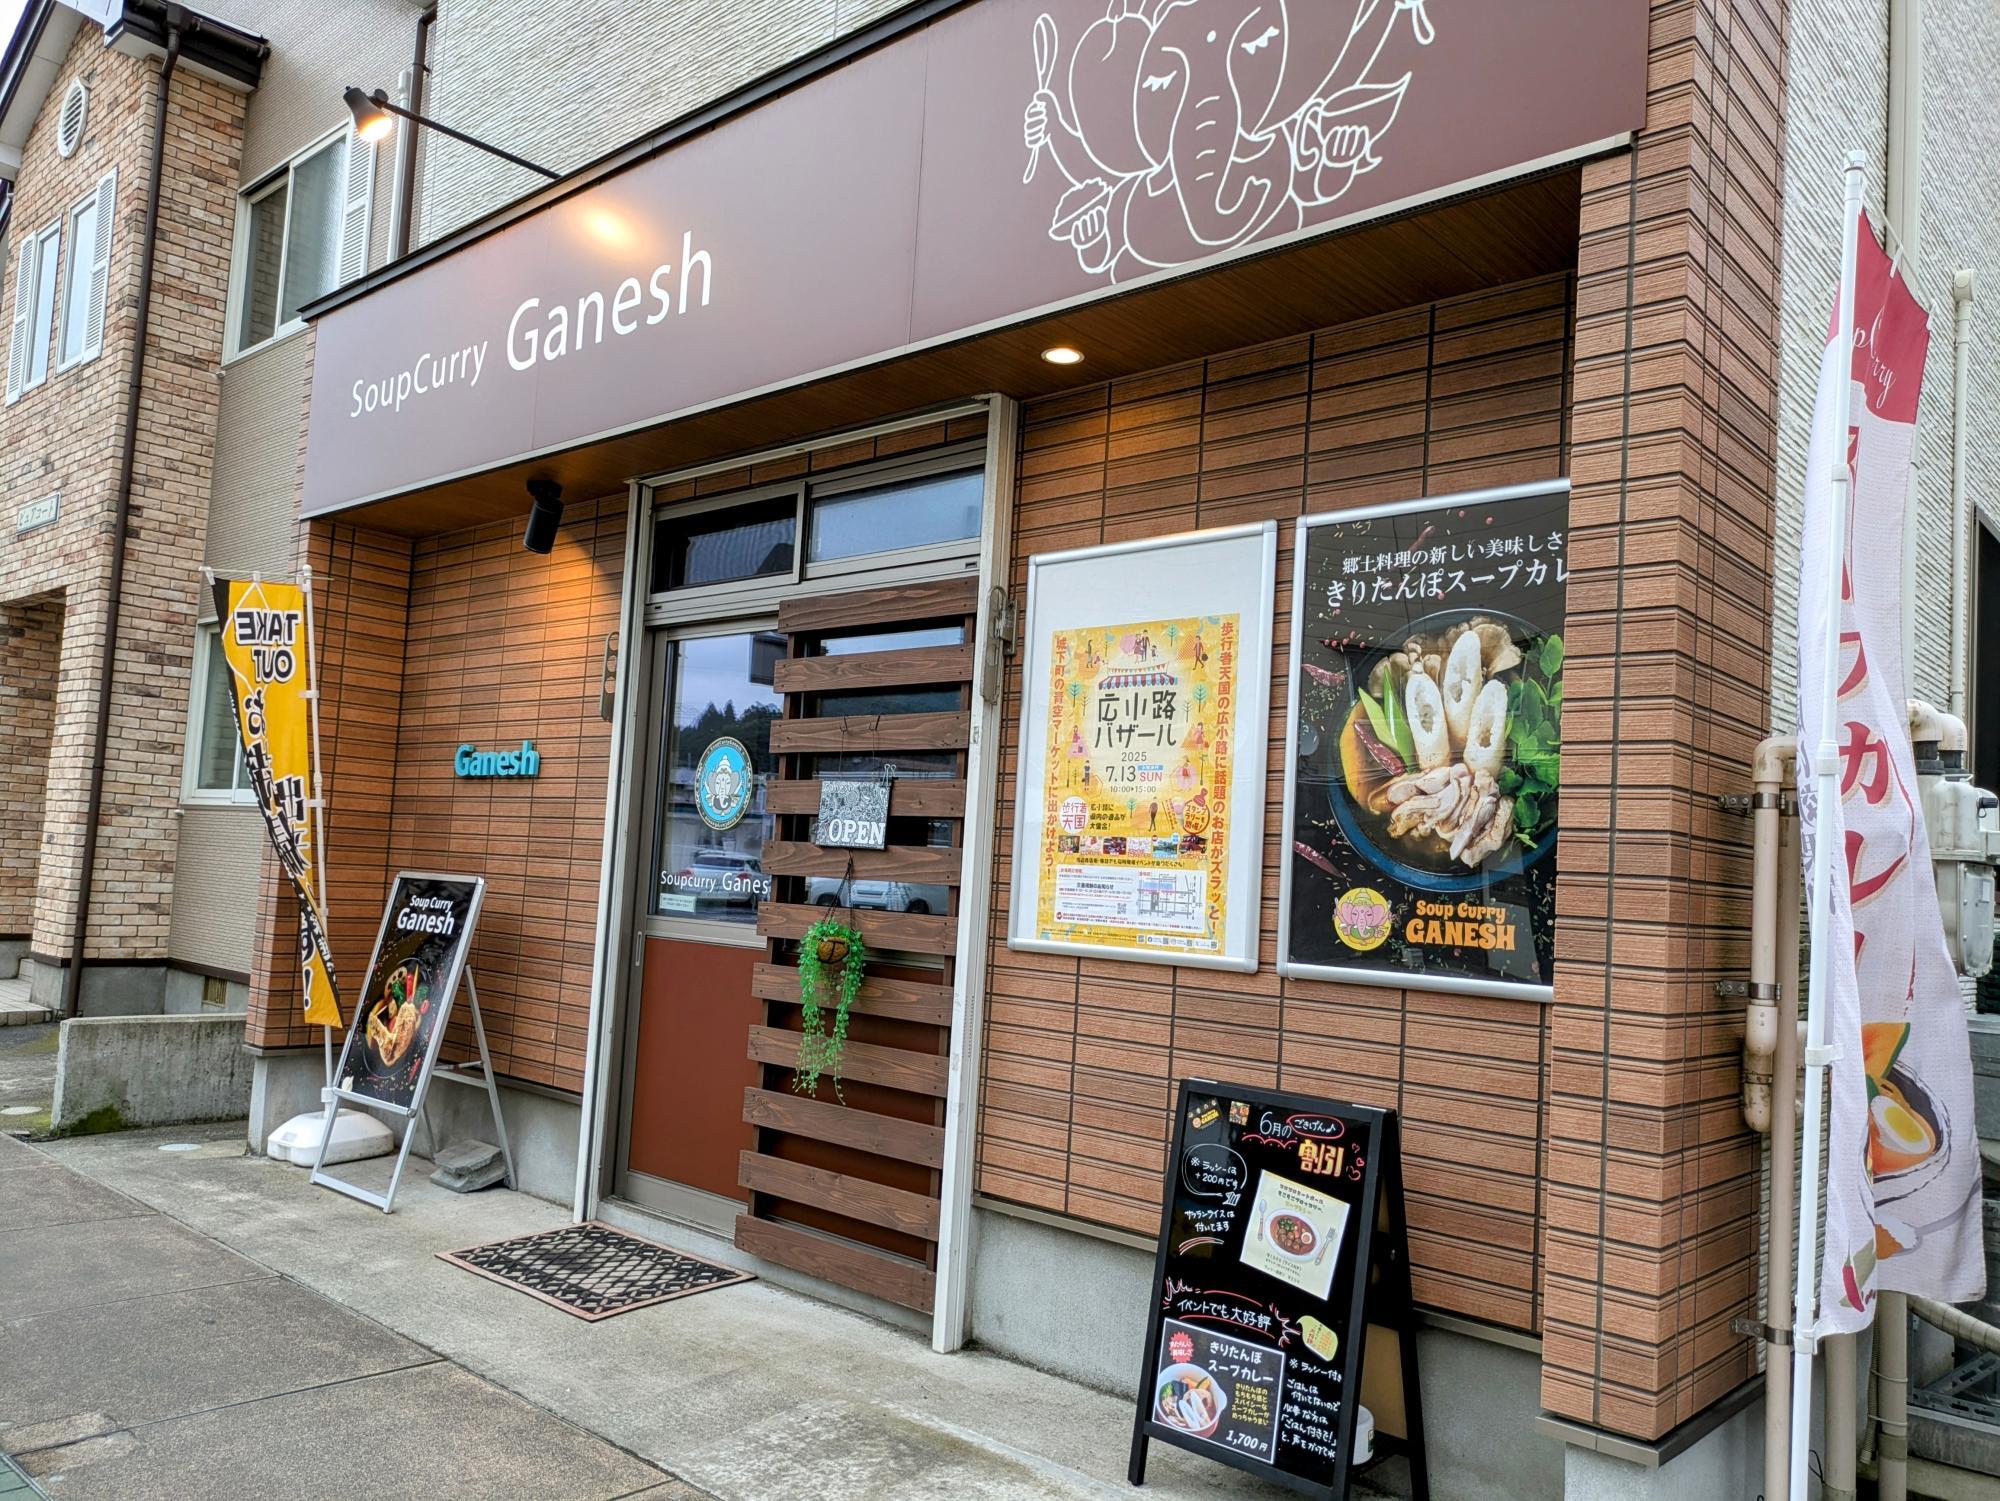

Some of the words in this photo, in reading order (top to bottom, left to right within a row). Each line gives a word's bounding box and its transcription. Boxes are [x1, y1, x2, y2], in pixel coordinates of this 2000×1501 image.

[350, 340, 488, 418] SoupCurry
[506, 230, 713, 371] Ganesh
[1342, 531, 1563, 575] 郷土料理の新しい美味しさ
[1326, 557, 1570, 607] きりたんぽスープカレ
[1098, 690, 1177, 722] 広小路
[1095, 722, 1177, 748] バザール
[454, 739, 541, 778] Ganesh
[1121, 751, 1147, 762] 2025
[1105, 765, 1136, 782] 7.13
[1139, 772, 1163, 782] SUN
[1062, 802, 1087, 813] 歩行者
[828, 818, 886, 845] OPEN
[1061, 814, 1086, 830] 天国
[660, 870, 717, 893] Soupcurry
[722, 872, 770, 895] Ganes
[410, 895, 429, 910] Soup
[430, 897, 454, 913] Curry
[1416, 900, 1455, 920] Soup
[1457, 902, 1506, 925] Curry
[396, 907, 456, 935] Ganesh
[1405, 917, 1516, 951] GANESH
[1260, 1111, 1292, 1138] 6月の
[1298, 1139, 1345, 1177] 割引
[1184, 1209, 1235, 1220] サフランライスは
[1195, 1221, 1230, 1232] 付いてます
[1177, 1299, 1272, 1332] イベントでも大好評
[1208, 1360, 1274, 1382] スープカレー
[1286, 1378, 1319, 1395] ごはんは
[1291, 1391, 1341, 1412] 付いてないので
[1226, 1429, 1268, 1451] 1,700円
